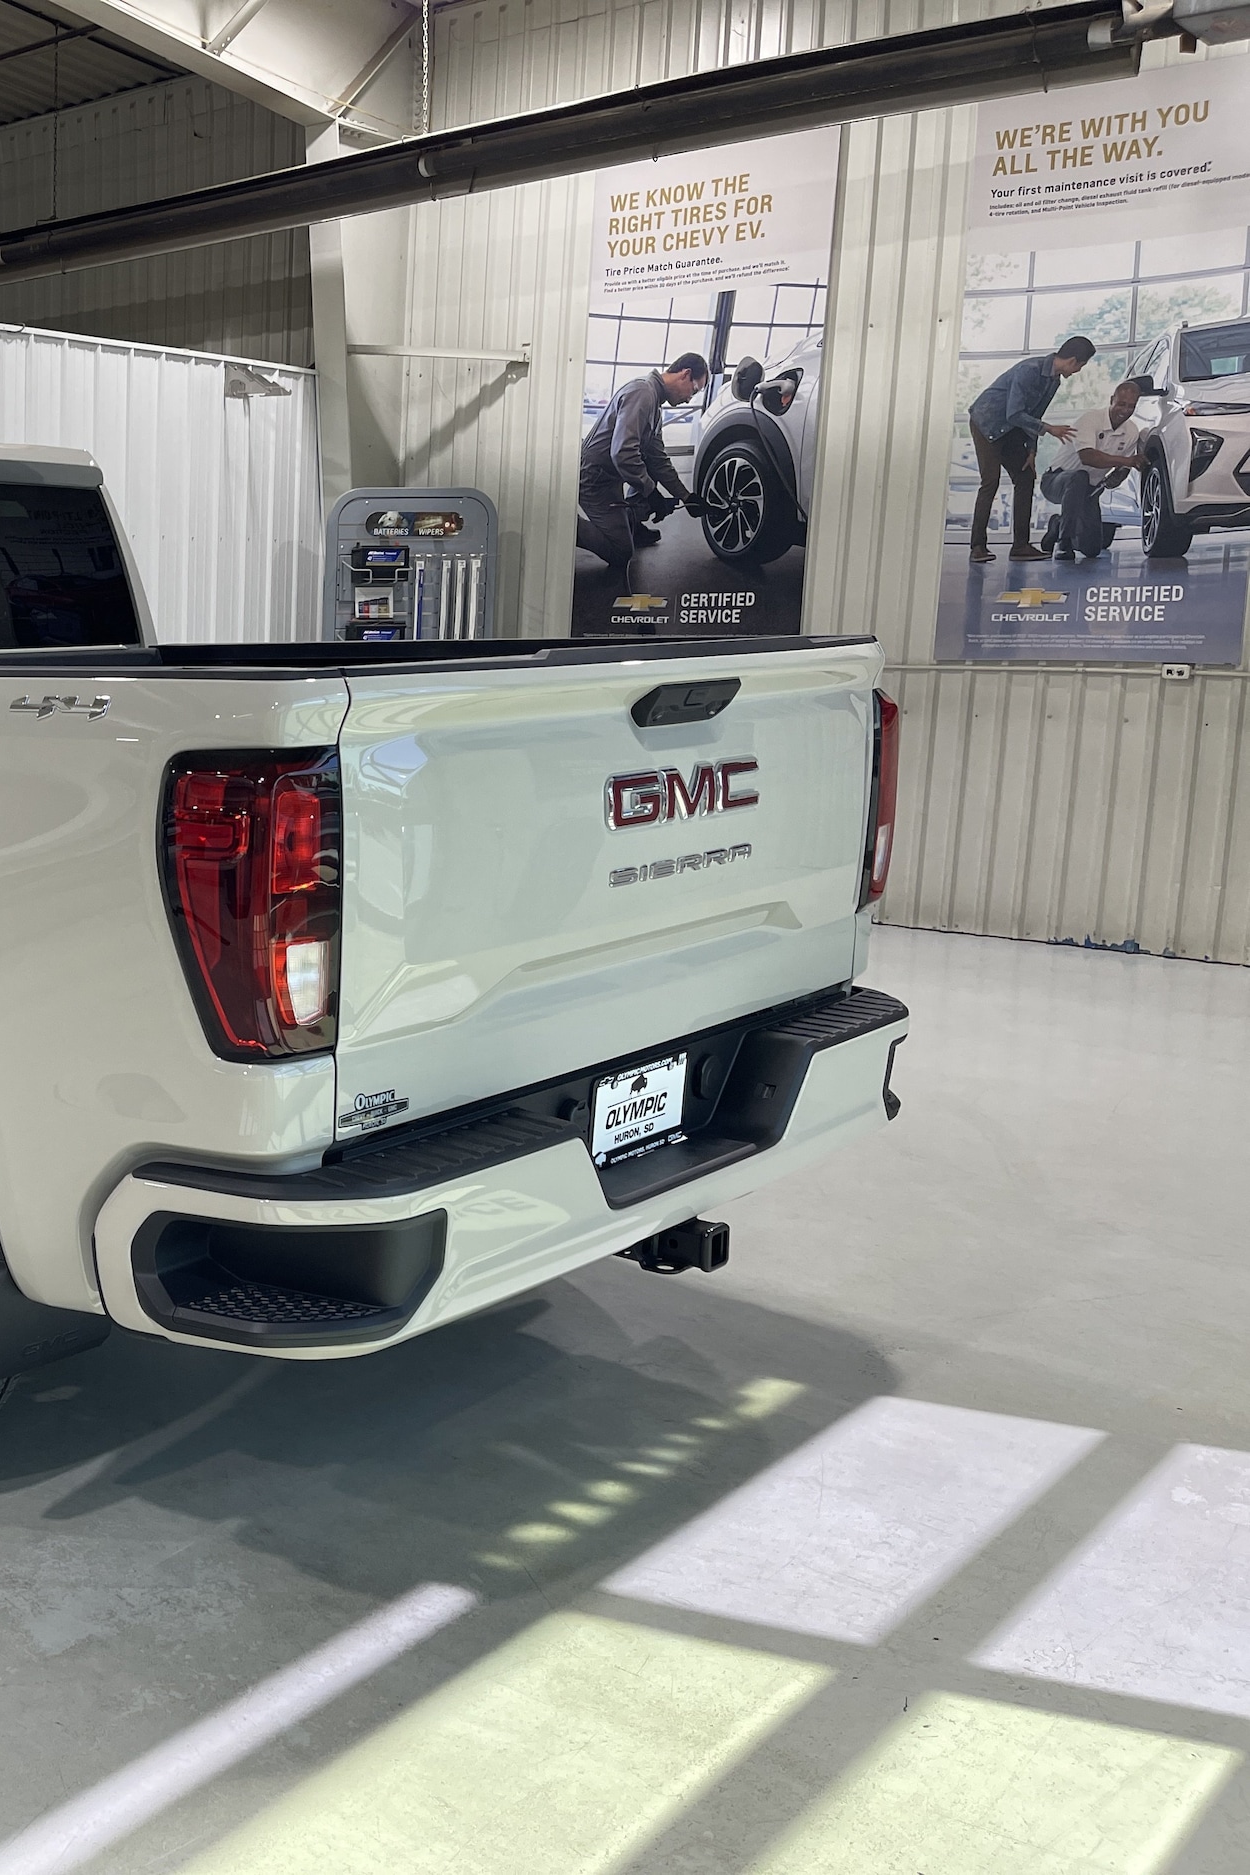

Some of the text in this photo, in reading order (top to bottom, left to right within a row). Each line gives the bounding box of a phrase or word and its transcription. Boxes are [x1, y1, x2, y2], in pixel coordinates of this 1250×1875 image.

[995, 100, 1210, 150] WE'RE WITH YOU
[992, 135, 1163, 177] ALL THE WAY.
[610, 173, 751, 213] WE KNOW THE
[990, 189, 1015, 198] Your
[1018, 185, 1042, 196] first
[1044, 178, 1116, 194] maintenance
[1119, 172, 1144, 184] visit
[1147, 170, 1156, 181] is
[608, 194, 773, 236] RIGHT TIRES FOR
[607, 220, 766, 259] YOUR CHEVY EV.
[605, 256, 723, 277] Tire Price Match Guarantee.
[373, 528, 409, 536] BATTERIES
[418, 528, 444, 536] WIPERS
[680, 592, 756, 607] CERTIFIED
[1085, 585, 1184, 603] CERTIFIED
[610, 615, 670, 624] CHEVROLET
[679, 609, 741, 624] SERVICE
[991, 613, 1070, 622] CHEVROLET
[1084, 605, 1166, 622] SERVICE
[604, 754, 760, 832] GMC
[608, 843, 753, 888] SIERRA
[605, 1091, 668, 1130] OLYMPIC
[613, 1122, 654, 1145] HURON, SD
